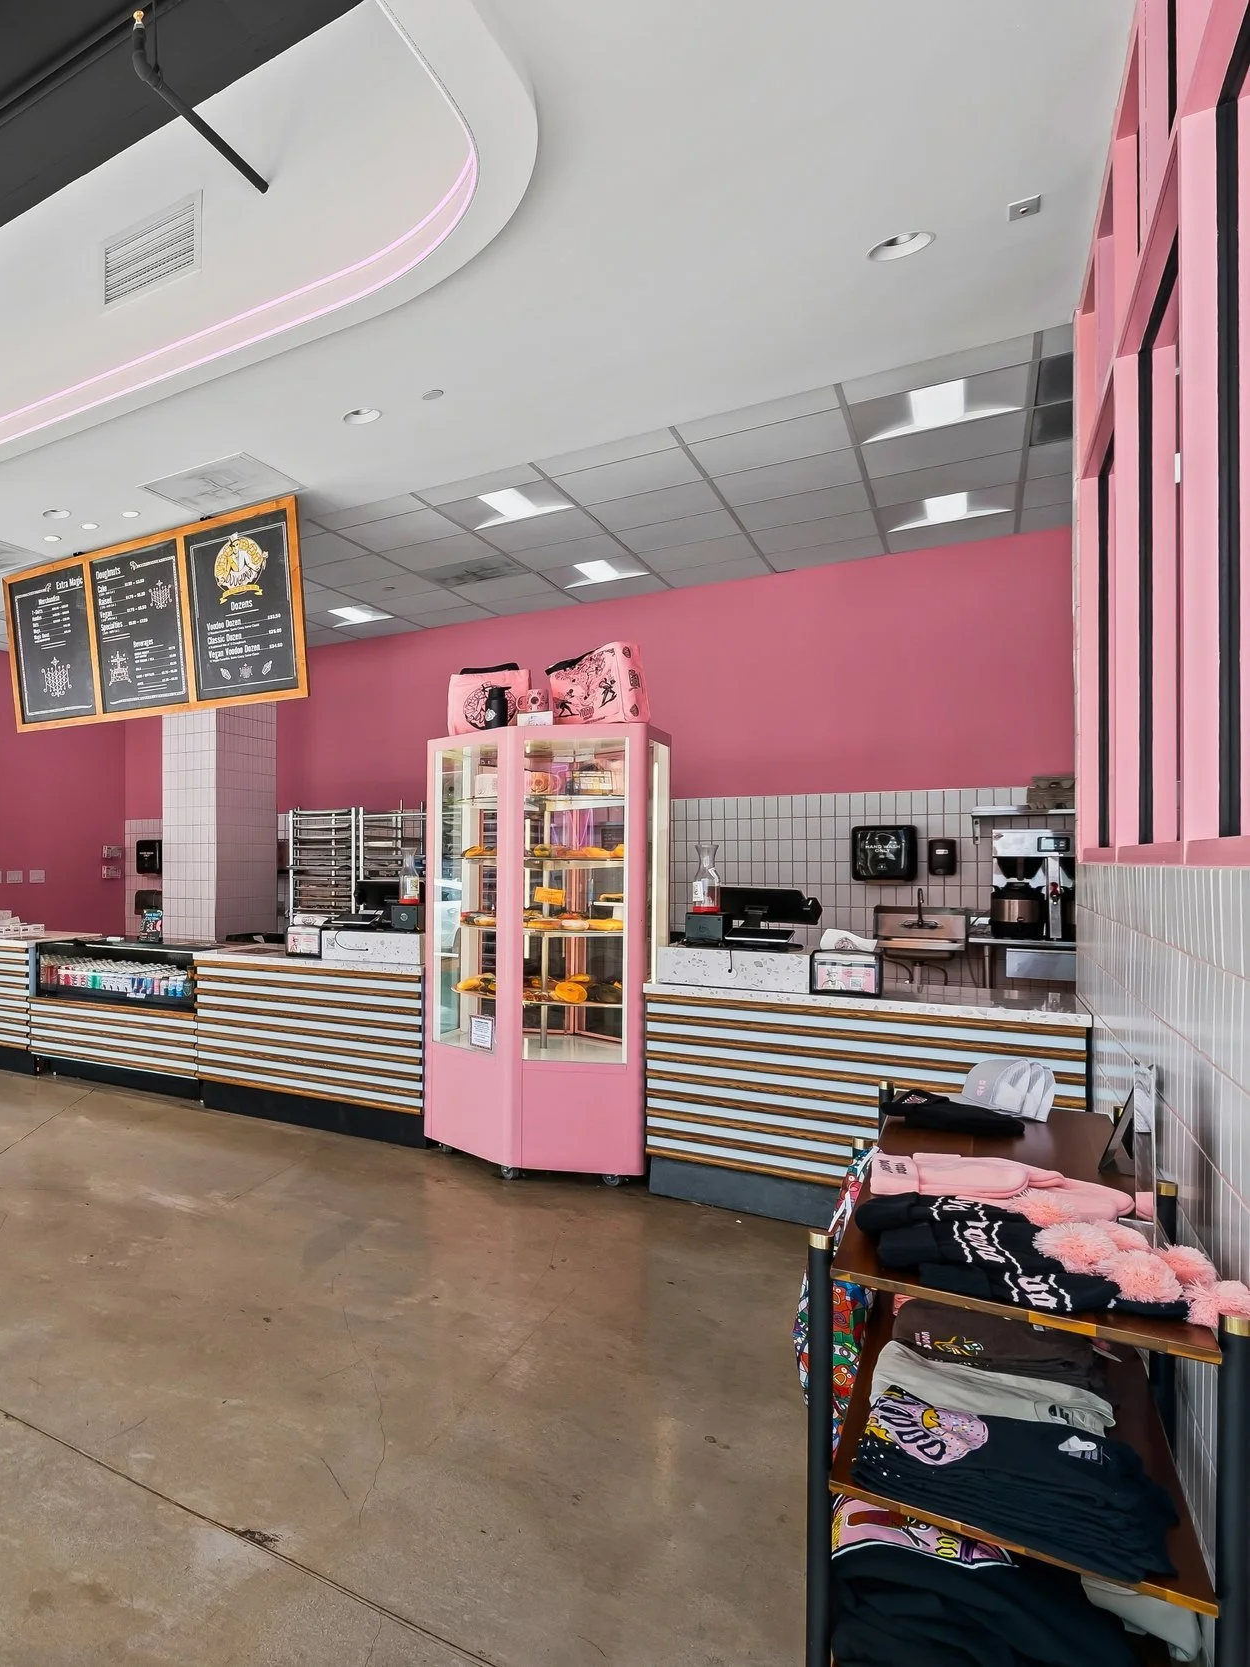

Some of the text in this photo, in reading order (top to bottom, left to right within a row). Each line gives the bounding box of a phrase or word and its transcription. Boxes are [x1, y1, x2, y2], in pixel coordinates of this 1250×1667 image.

[96, 566, 121, 580] Doughnuts
[56, 576, 83, 590] Extra Magic
[97, 585, 108, 593] Cake
[98, 596, 112, 606] Raised
[230, 600, 253, 611] Dozens
[100, 610, 112, 620] Vegan
[100, 621, 123, 632] Specialties
[206, 622, 224, 631] Voodoo
[225, 619, 241, 628] Dozen
[133, 639, 154, 648] Beverages
[207, 635, 225, 645] Classic
[226, 633, 242, 642] Dozen
[208, 650, 224, 659] Vegan
[225, 647, 243, 656] Voodoo
[244, 644, 260, 653] Dozen
